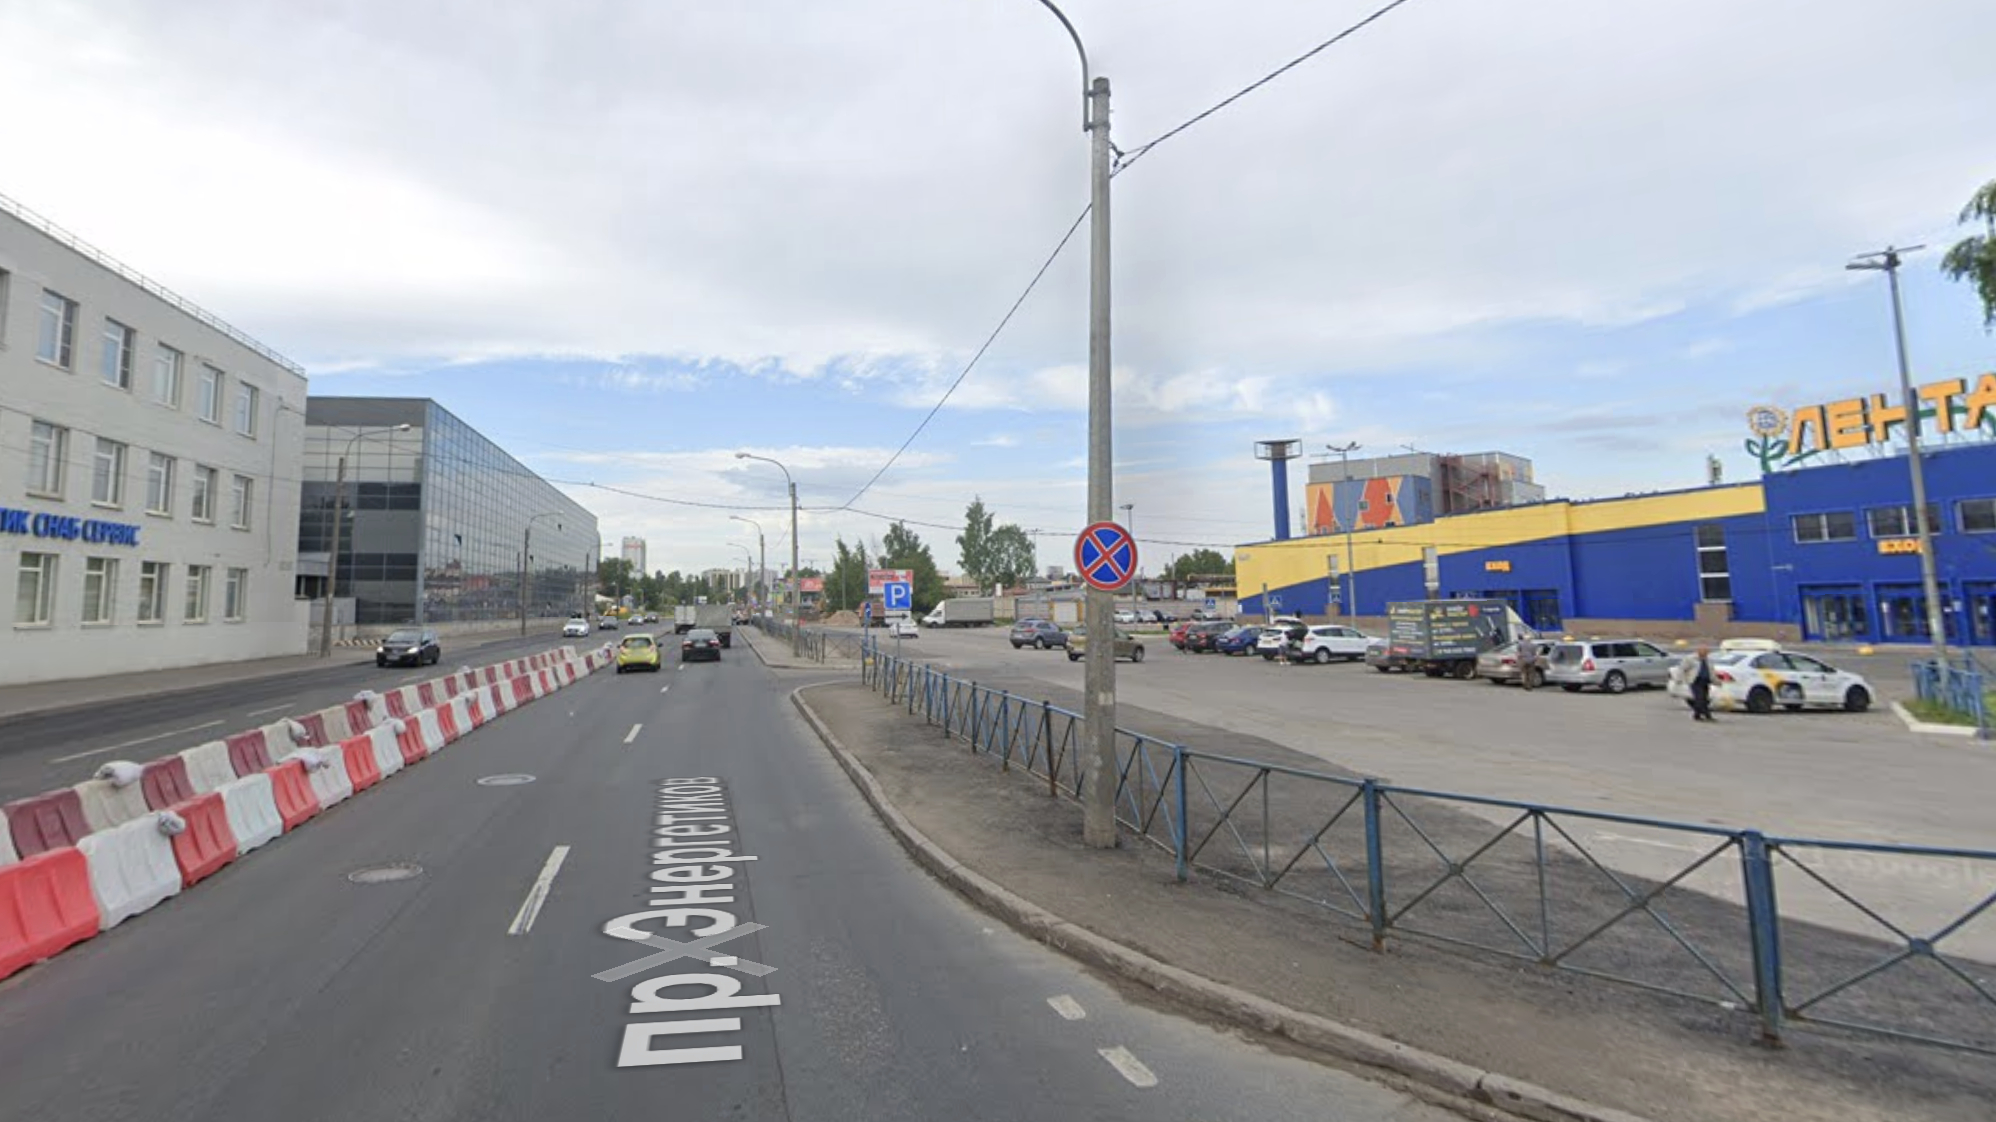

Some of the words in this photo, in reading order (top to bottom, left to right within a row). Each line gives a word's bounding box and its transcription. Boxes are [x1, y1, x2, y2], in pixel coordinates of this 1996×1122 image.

[1788, 372, 1996, 454] ЛЕНТА
[33, 513, 81, 540] СНАБ
[81, 518, 140, 546] СЕРВИС
